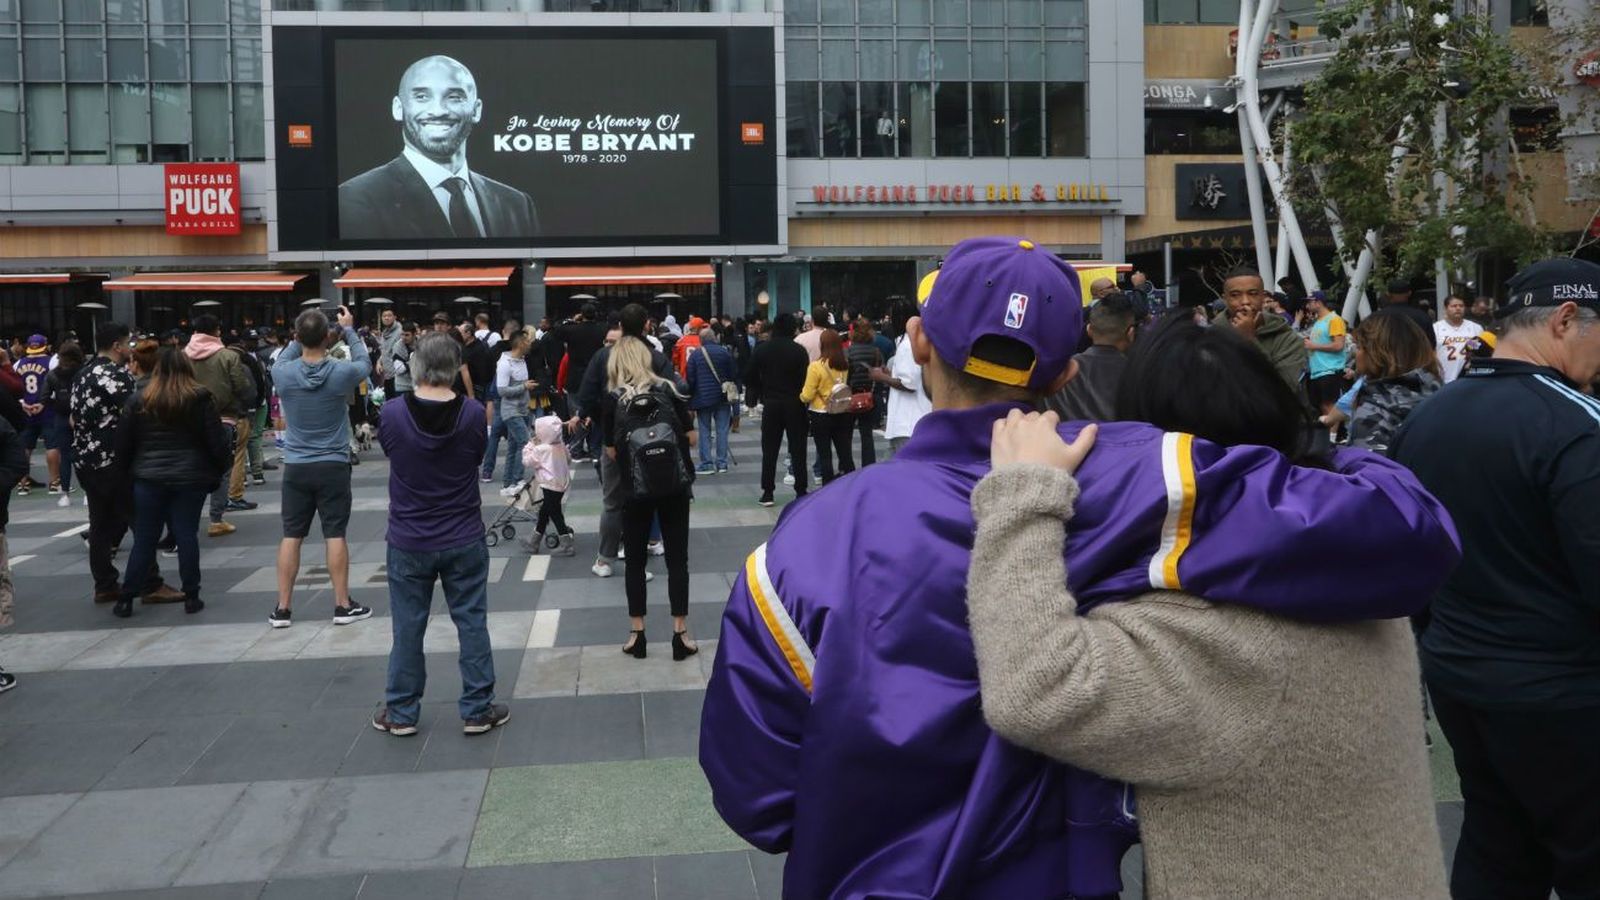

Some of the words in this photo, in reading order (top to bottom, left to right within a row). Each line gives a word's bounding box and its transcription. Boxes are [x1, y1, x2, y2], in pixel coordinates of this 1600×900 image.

[507, 115, 528, 131] In
[533, 115, 582, 132] Loving
[587, 114, 652, 133] Memory
[656, 114, 681, 131] Of
[494, 134, 571, 152] KOBE
[582, 133, 695, 151] BRYANT
[563, 154, 588, 163] 1978
[599, 154, 627, 163] 2020
[169, 174, 232, 185] WOLFGANG
[170, 188, 235, 215] PUCK
[812, 185, 917, 203] WOLFGANG
[928, 185, 974, 203] PUCK
[986, 183, 1020, 203] BAR
[1030, 184, 1046, 202] &
[1056, 183, 1110, 203] GRILL
[1553, 283, 1598, 294] FINAL
[25, 374, 38, 394] 8
